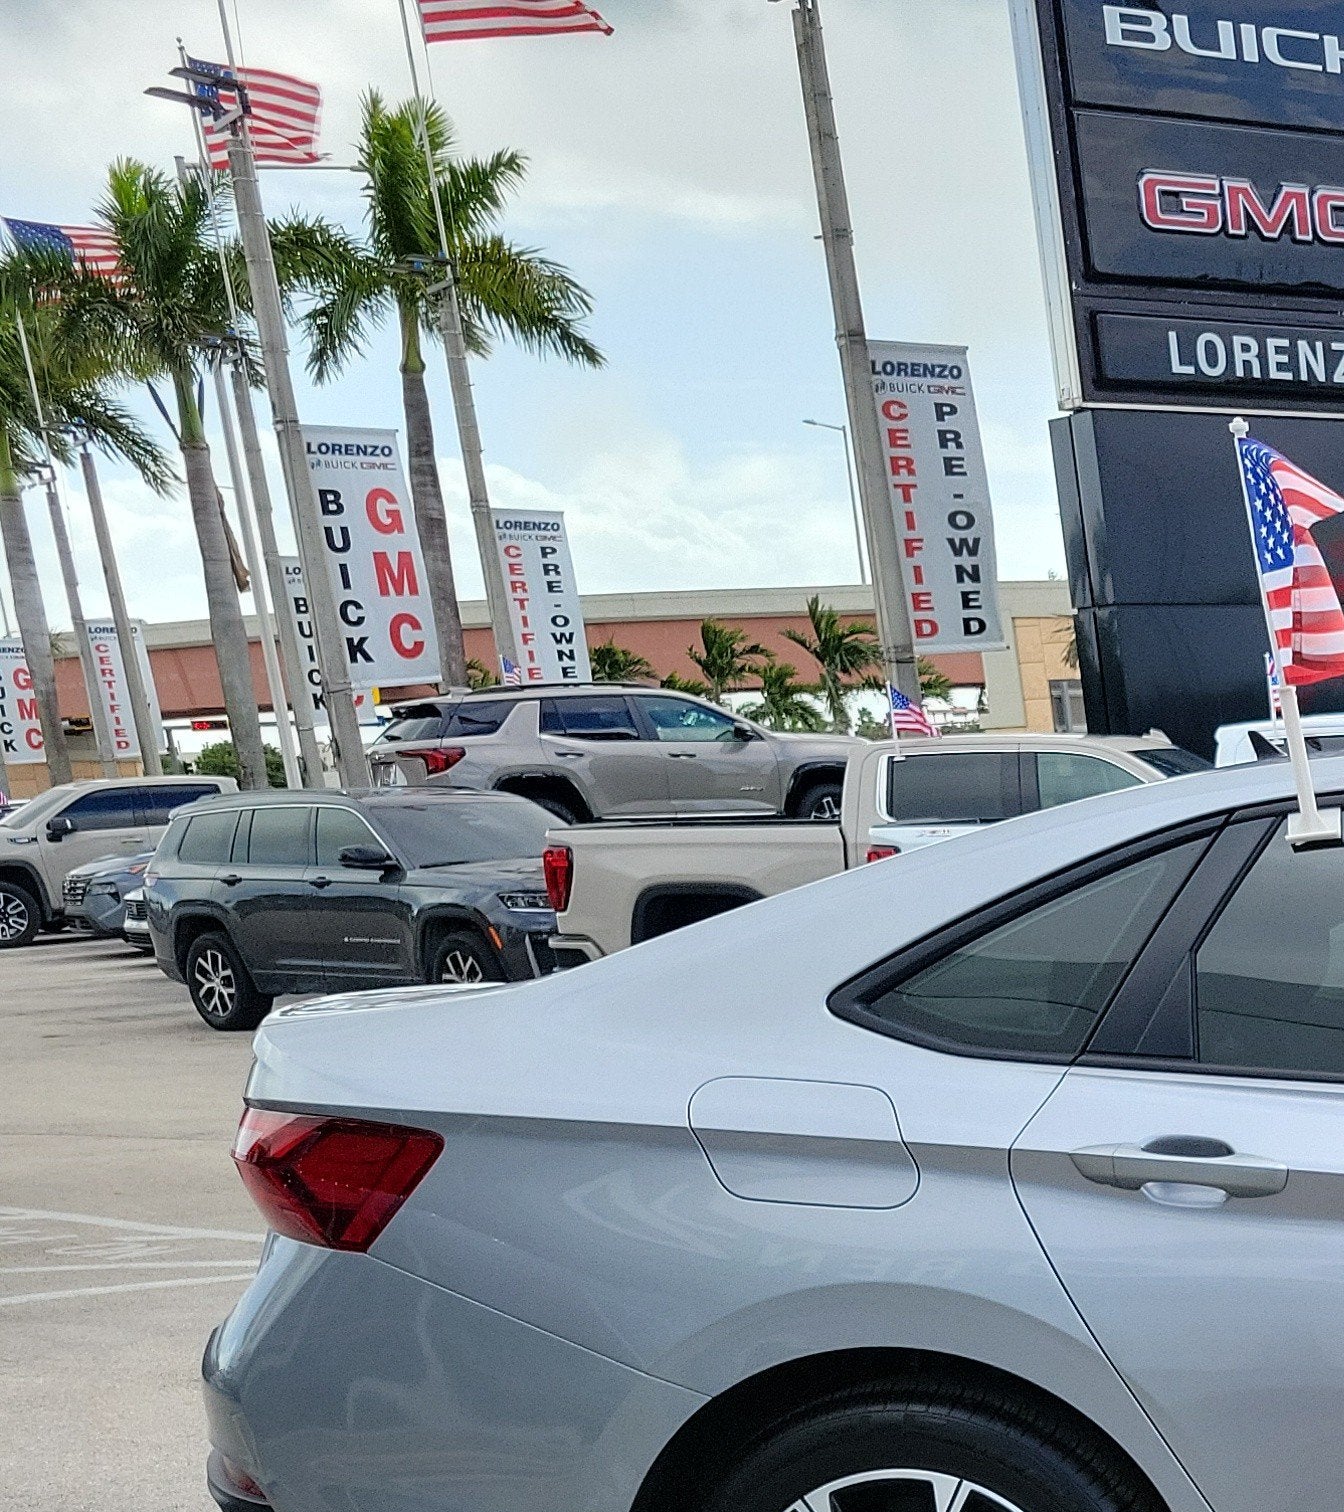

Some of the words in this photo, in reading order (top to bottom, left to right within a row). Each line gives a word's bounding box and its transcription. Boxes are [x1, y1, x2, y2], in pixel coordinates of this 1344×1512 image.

[871, 360, 962, 380] LORENZO
[889, 382, 925, 394] BUICK
[927, 385, 966, 396] GMC
[306, 442, 393, 457] LORENZO
[324, 460, 358, 470] BUICK
[360, 462, 397, 471] GMC
[496, 520, 560, 532] LORENZO
[881, 399, 939, 640] CERTIFIED
[934, 402, 987, 637] PRE-OWNED
[318, 488, 375, 664] BUICK
[365, 487, 425, 660] GMC
[504, 545, 543, 680] CERTIFIE
[540, 546, 577, 679] PRE-OWNE
[13, 667, 44, 750] GMC
[95, 643, 130, 750] CERTIFIED
